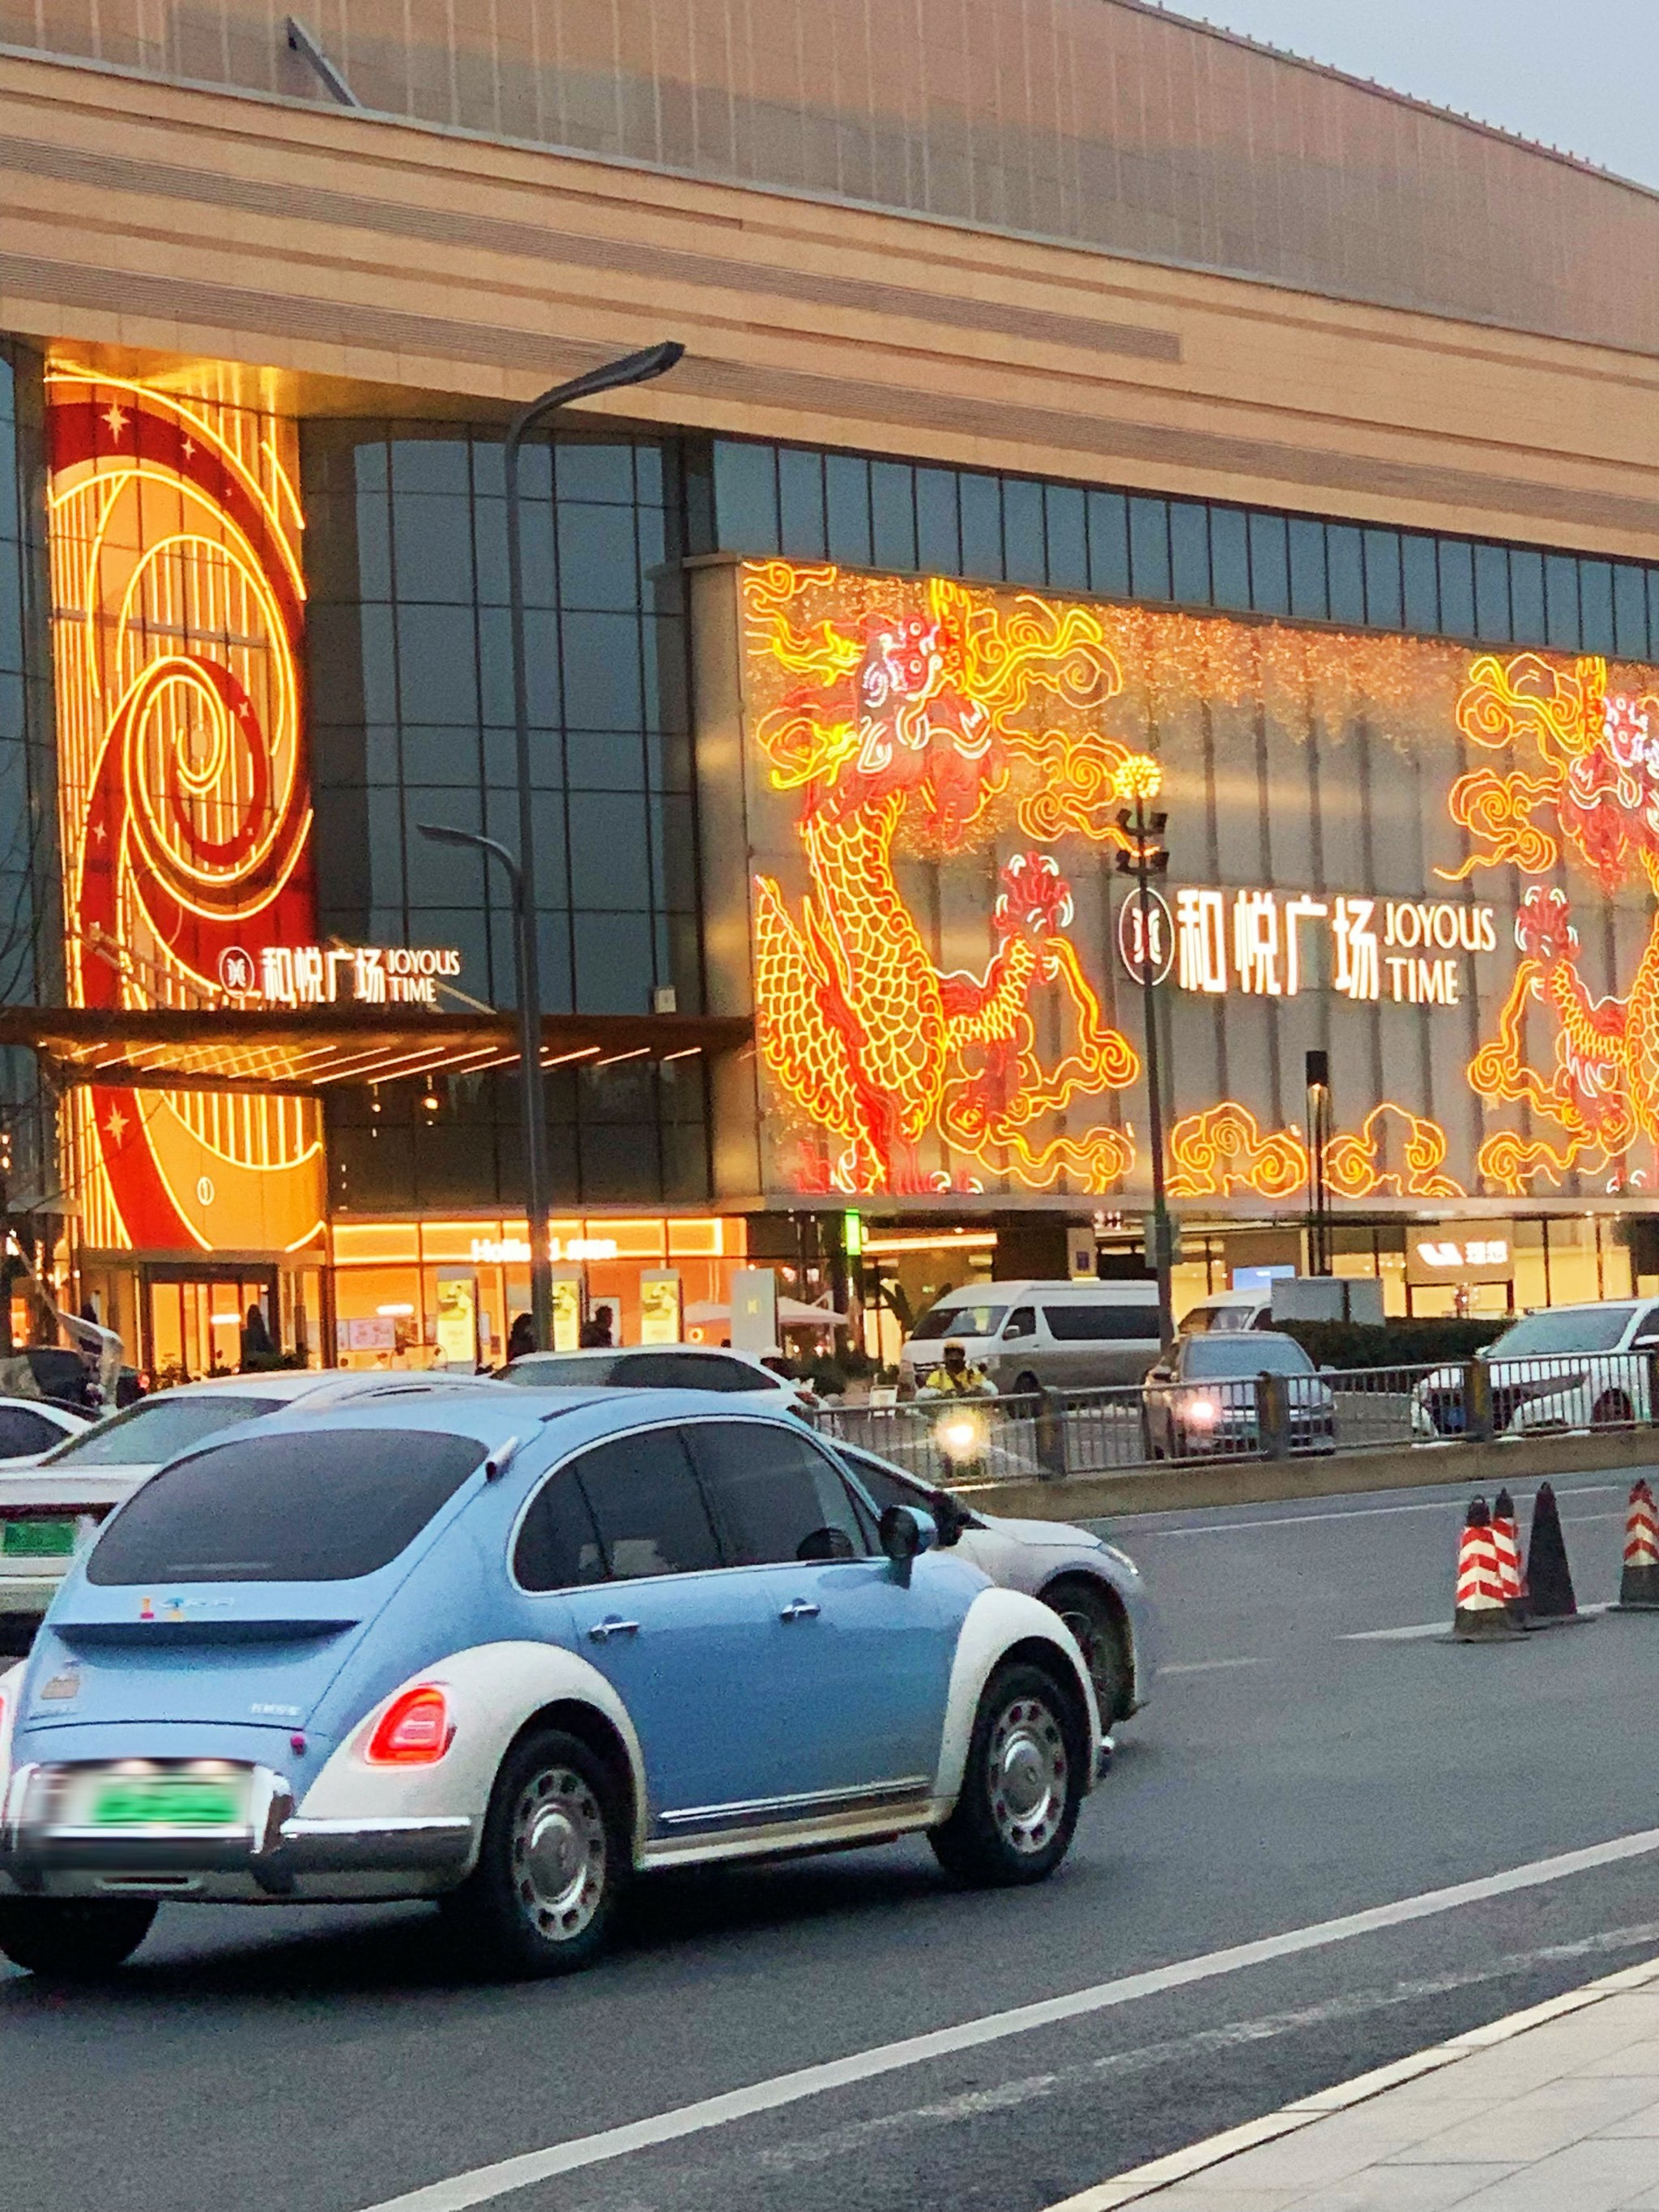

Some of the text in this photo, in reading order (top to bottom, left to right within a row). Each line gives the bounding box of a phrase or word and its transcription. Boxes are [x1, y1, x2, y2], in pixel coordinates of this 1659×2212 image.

[1177, 889, 1379, 1000] 和悦广场
[1384, 902, 1497, 951] JOYOUS
[262, 946, 386, 1003] 和悦广场
[387, 949, 461, 976] JOYOUS
[1384, 957, 1459, 1005] TIME
[388, 976, 437, 1003] TIME
